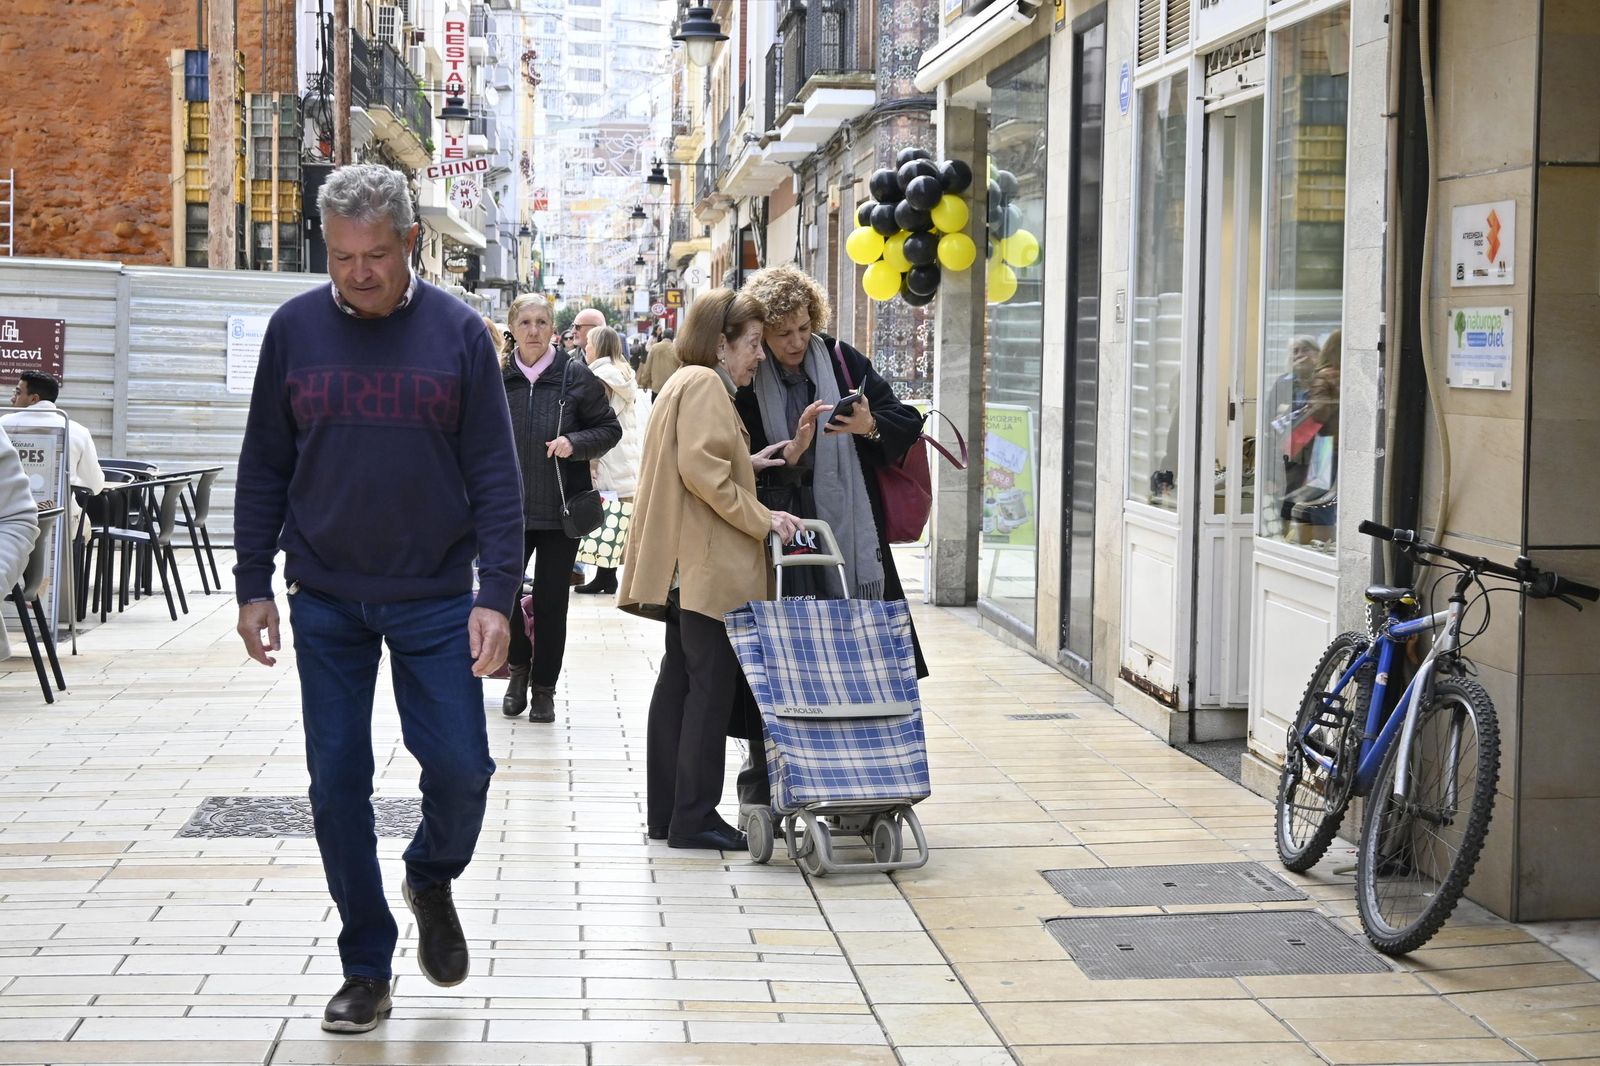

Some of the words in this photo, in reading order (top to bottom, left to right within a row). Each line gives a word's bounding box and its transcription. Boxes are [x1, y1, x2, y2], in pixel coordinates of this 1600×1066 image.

[445, 22, 464, 158] RESTAUTE
[427, 159, 487, 179] CHINO
[0, 347, 42, 360] ucavi
[19, 450, 44, 463] PES
